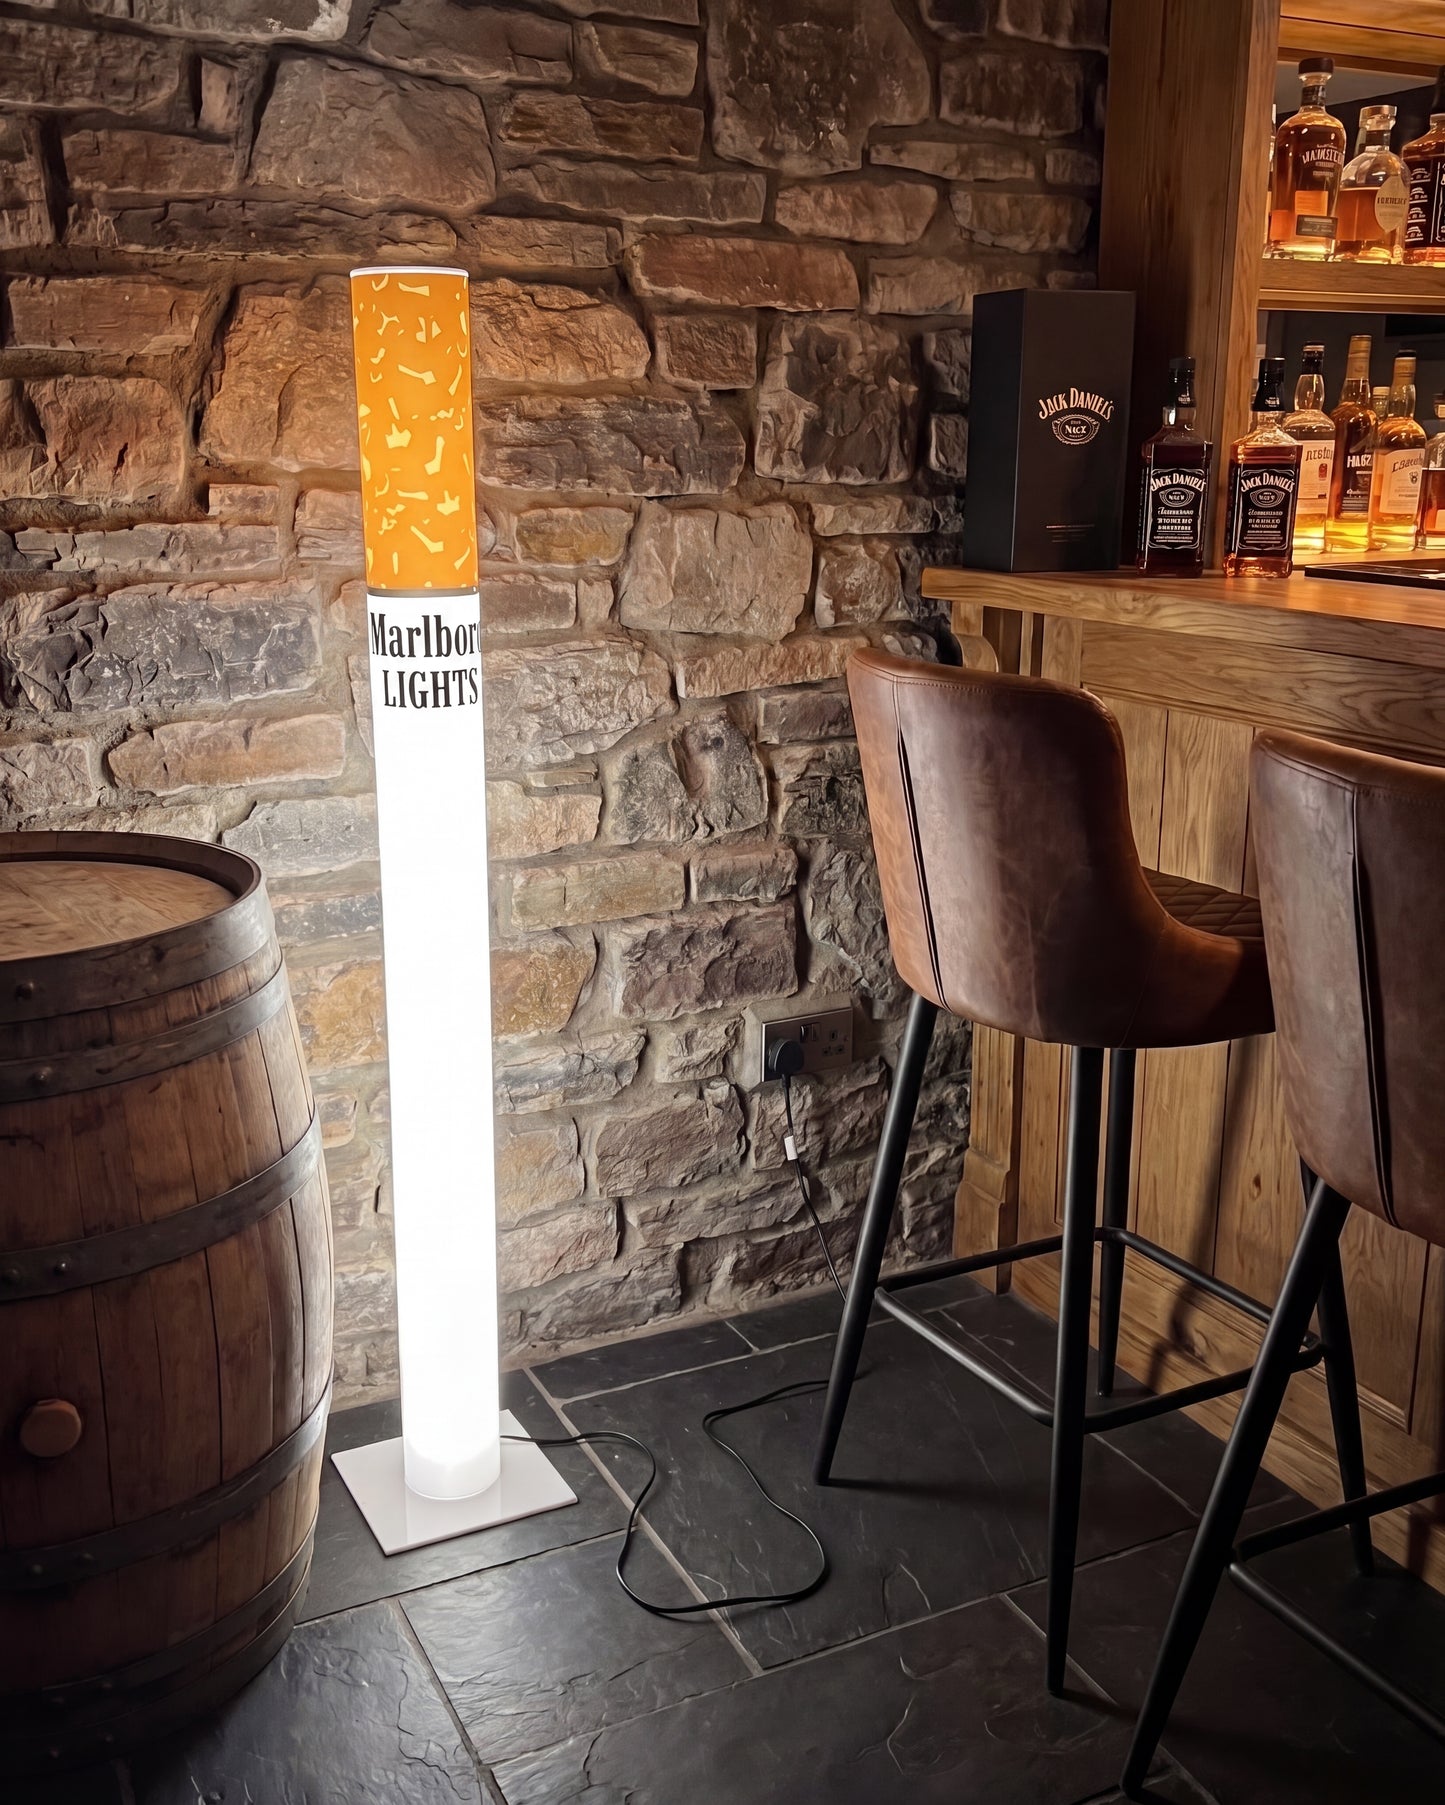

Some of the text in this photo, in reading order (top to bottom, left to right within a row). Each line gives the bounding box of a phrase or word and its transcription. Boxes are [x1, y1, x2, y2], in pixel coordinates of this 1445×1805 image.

[1039, 387, 1115, 420] JACK DANIEL'S
[1150, 475, 1172, 492] JACK
[1241, 476, 1262, 493] JACK
[382, 667, 478, 709] LIGHTS
